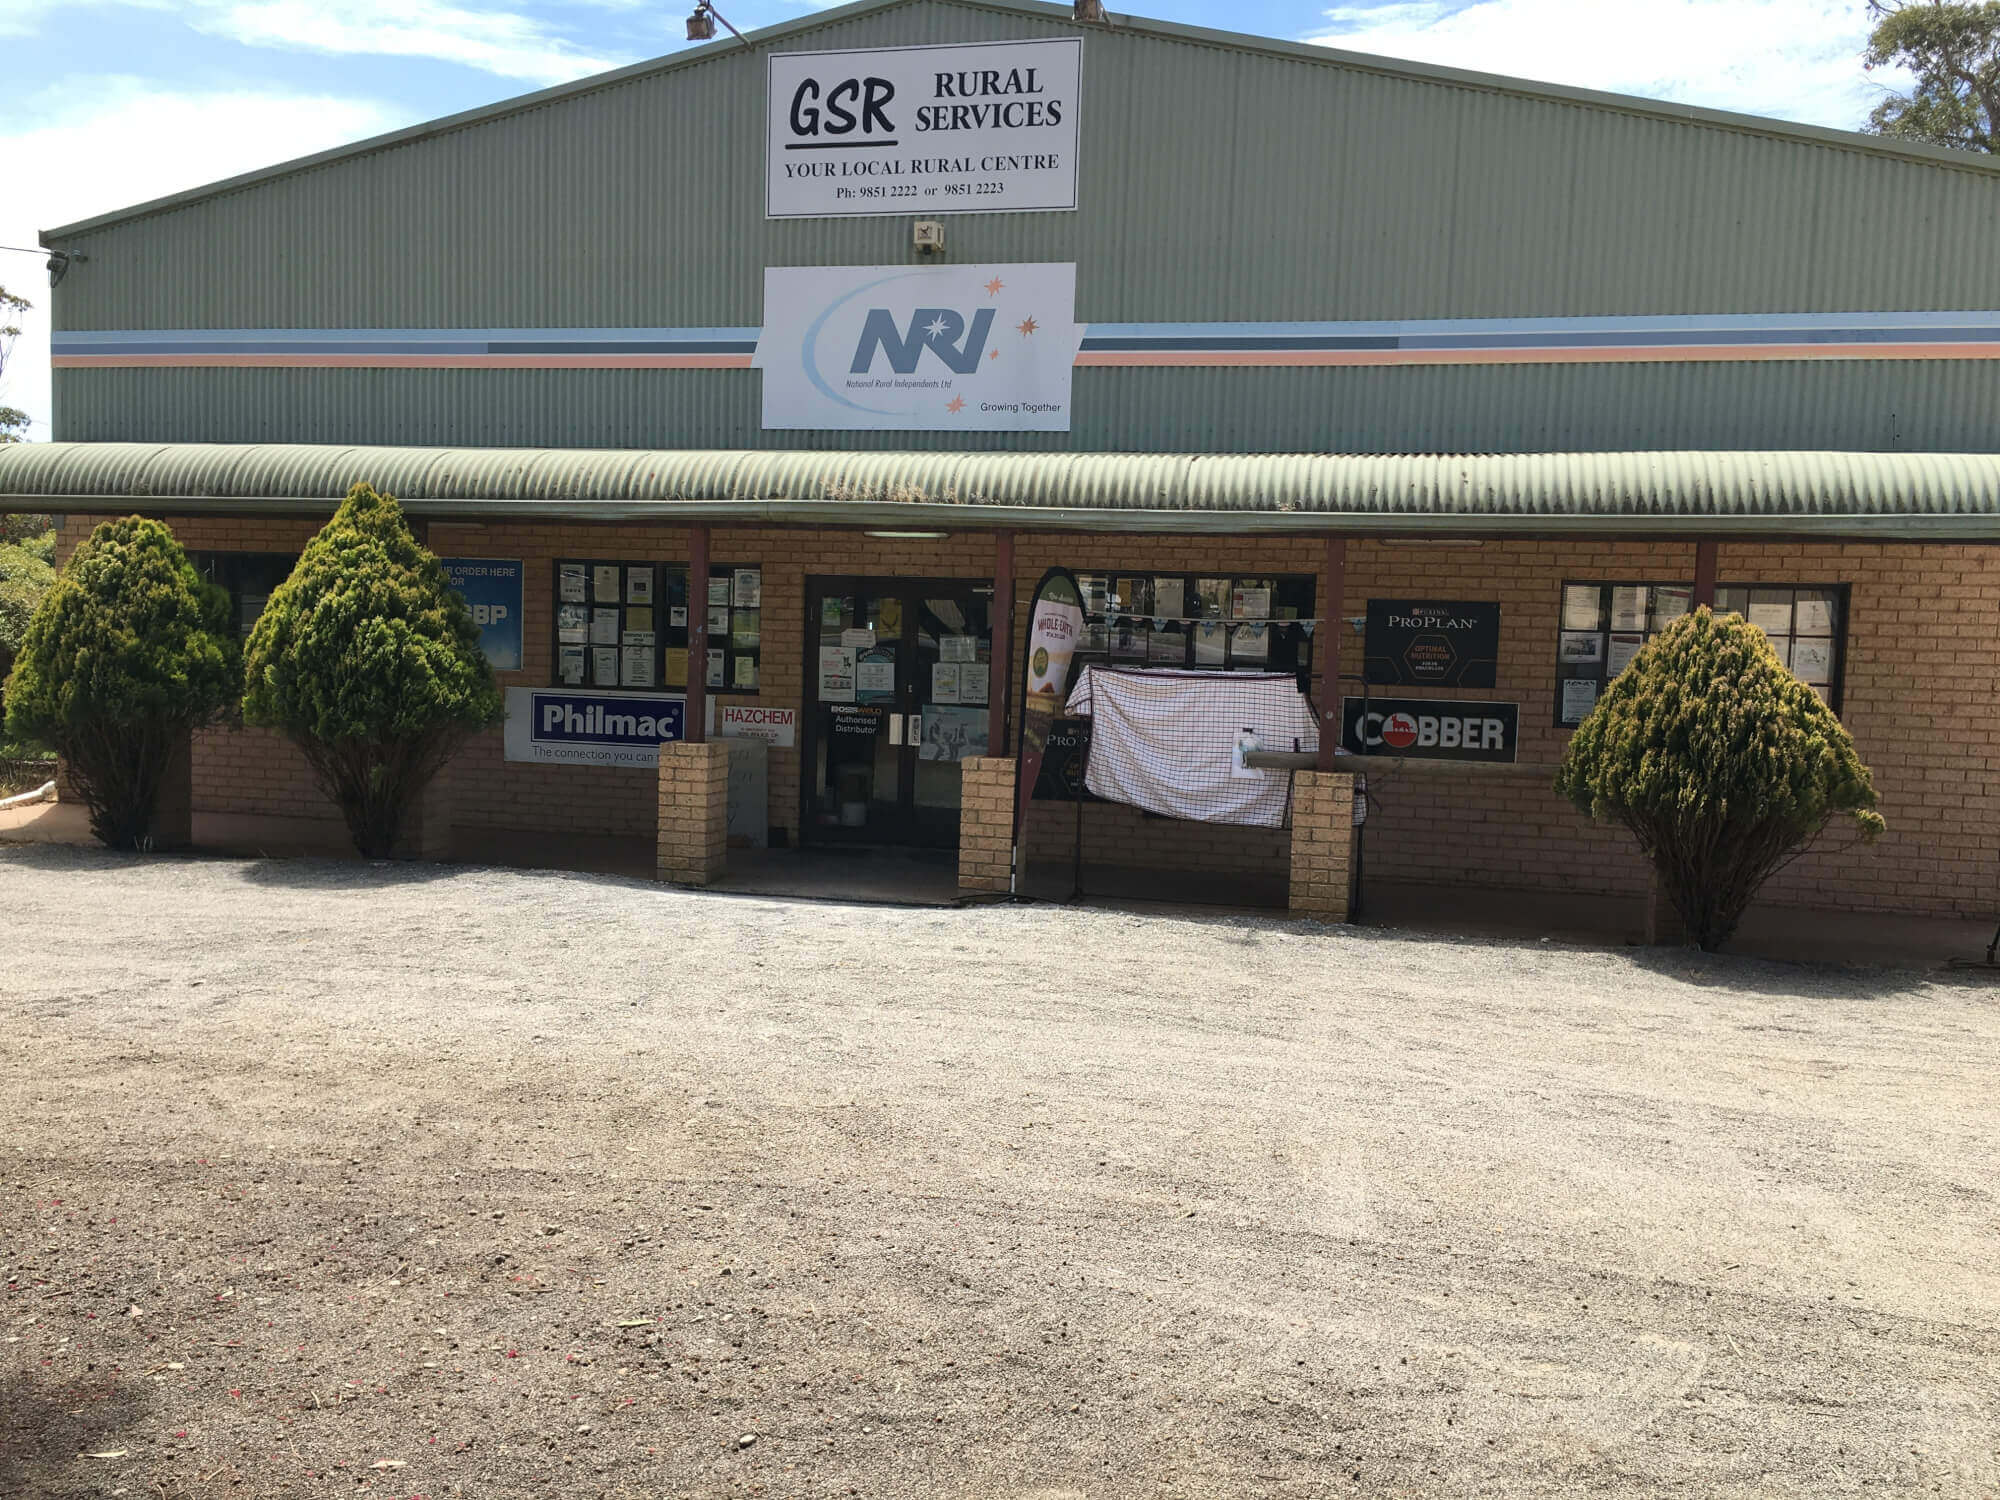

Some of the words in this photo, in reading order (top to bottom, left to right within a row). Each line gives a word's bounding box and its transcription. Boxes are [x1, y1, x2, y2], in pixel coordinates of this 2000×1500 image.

[934, 68, 1043, 98] RURAL
[790, 77, 896, 136] GSR
[915, 100, 1062, 132] SERVICES
[785, 162, 836, 178] YOUR
[842, 160, 905, 177] LOCAL
[911, 157, 976, 175] RURAL
[981, 153, 1059, 172] CENTRE
[836, 187, 856, 199] Ph:
[859, 186, 887, 198] 9851
[890, 185, 918, 198] 2222
[924, 186, 938, 196] or
[944, 184, 972, 196] 9851
[976, 182, 1004, 195] 2223
[849, 308, 997, 374] NRI
[845, 379, 874, 389] National
[875, 379, 893, 389] Rural
[894, 379, 939, 391] Independents
[940, 379, 952, 389] Ltd
[980, 402, 1019, 414] Growing
[1021, 402, 1062, 414] Together
[455, 566, 488, 576] ORDER
[490, 567, 515, 577] HERE
[543, 704, 675, 739] Philmac
[725, 708, 793, 725] HAZCHEM
[835, 715, 877, 725] Authorised
[835, 725, 877, 735] Distributor
[533, 746, 550, 759] The
[554, 748, 611, 762] connection
[613, 751, 633, 764] you
[636, 752, 653, 763] can
